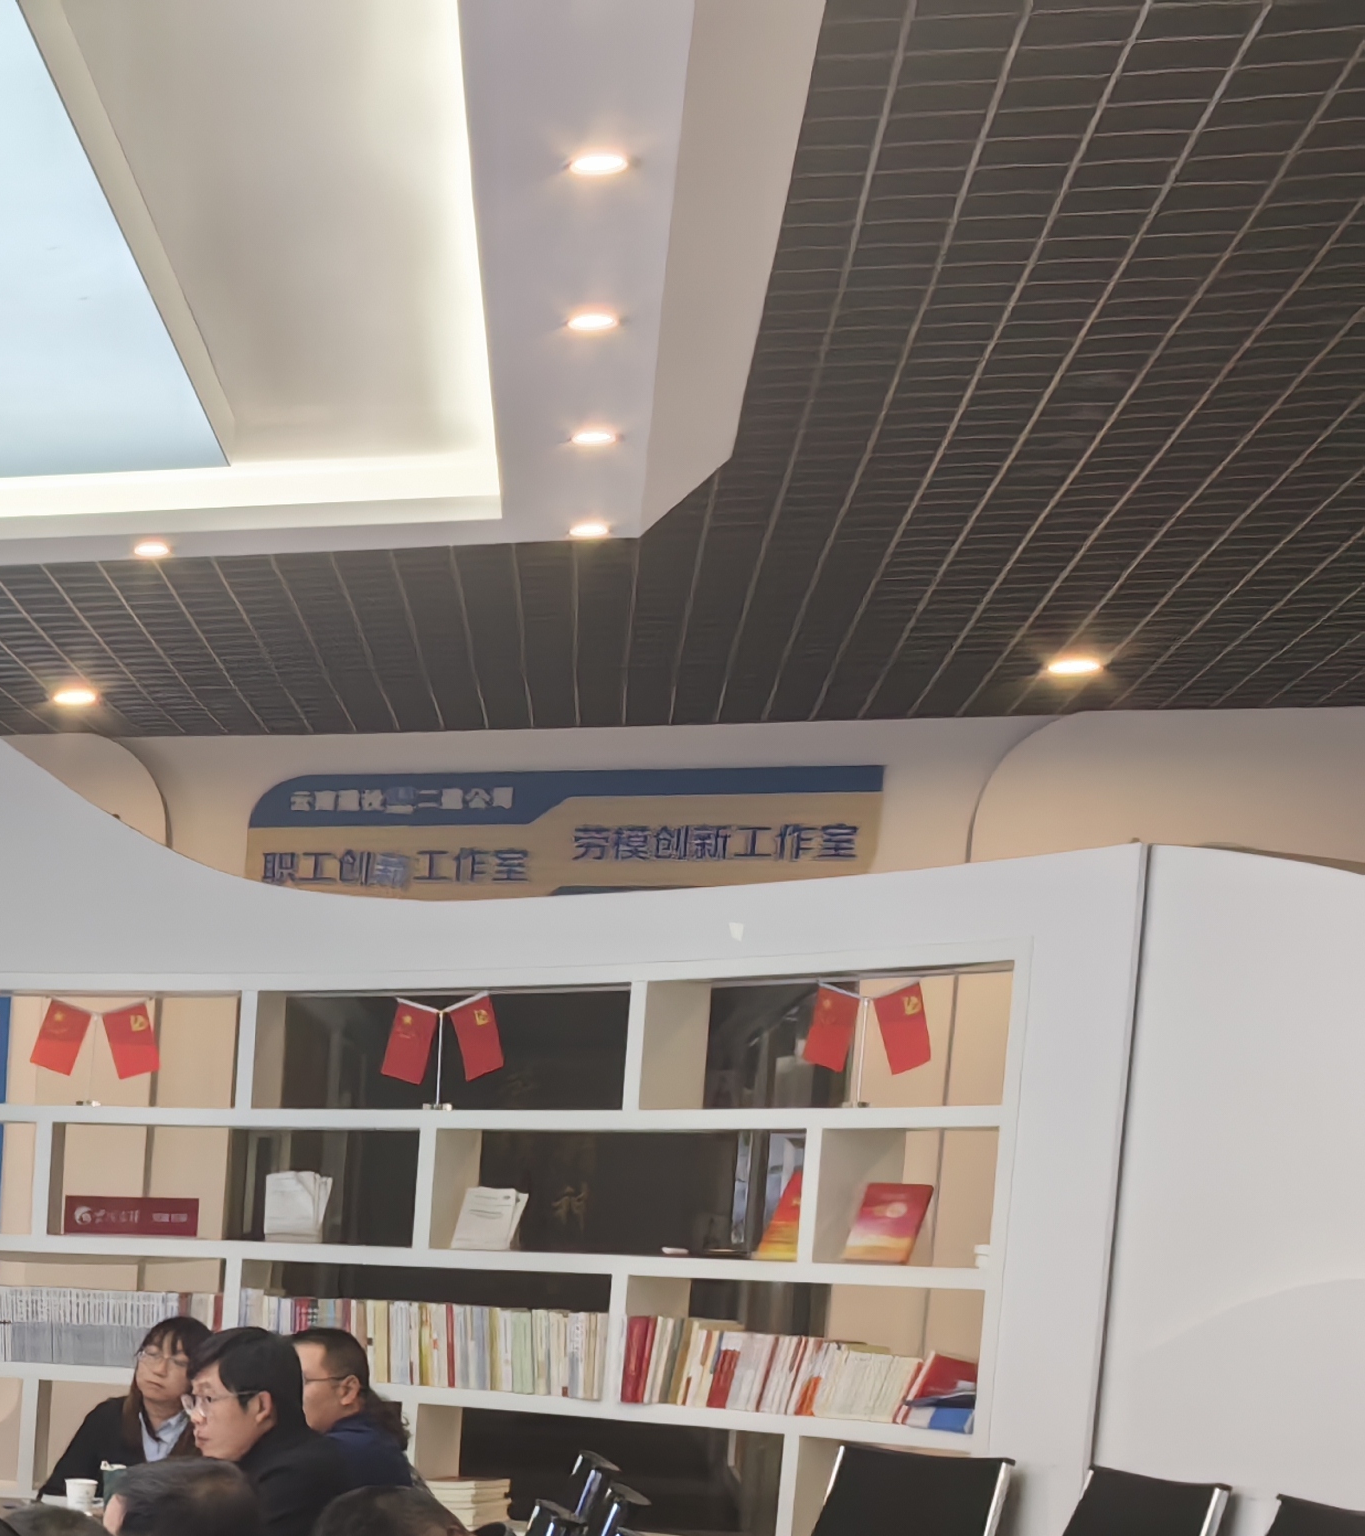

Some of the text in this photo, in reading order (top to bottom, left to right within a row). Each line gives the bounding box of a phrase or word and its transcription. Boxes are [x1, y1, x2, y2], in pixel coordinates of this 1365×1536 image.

[571, 823, 859, 862] 劳模创新工作室
[262, 848, 530, 888] 职工创新工作室
